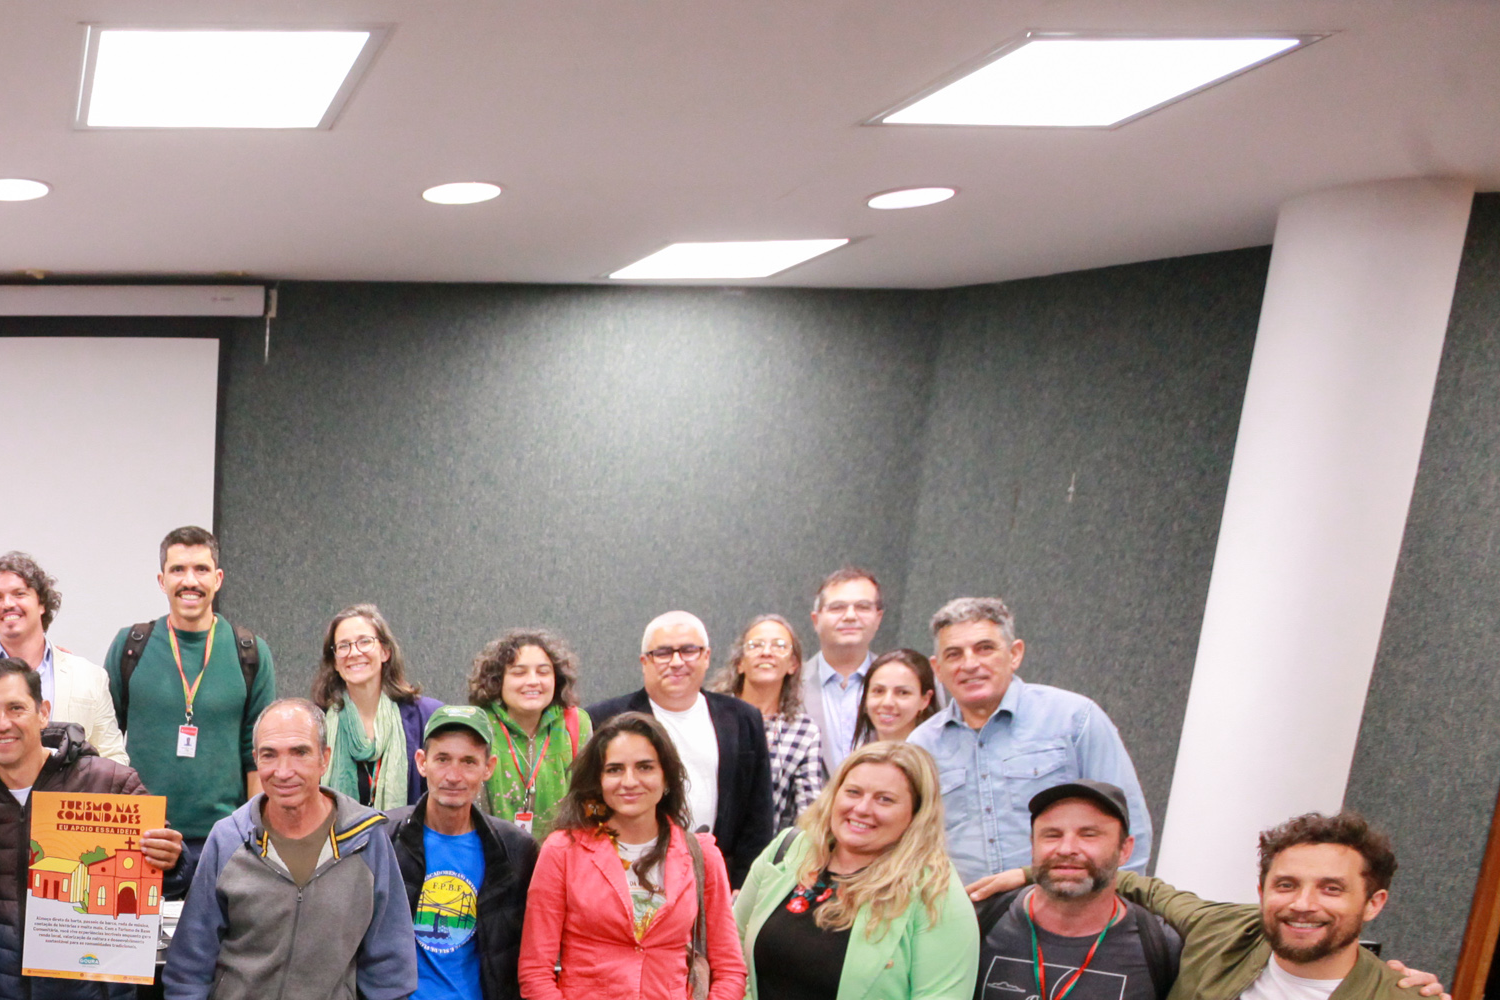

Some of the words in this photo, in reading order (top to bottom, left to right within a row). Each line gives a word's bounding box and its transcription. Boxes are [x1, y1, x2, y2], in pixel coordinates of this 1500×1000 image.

[60, 800, 112, 811] TURISMO
[116, 803, 139, 813] NAS
[57, 810, 141, 824] COMUNIDADES
